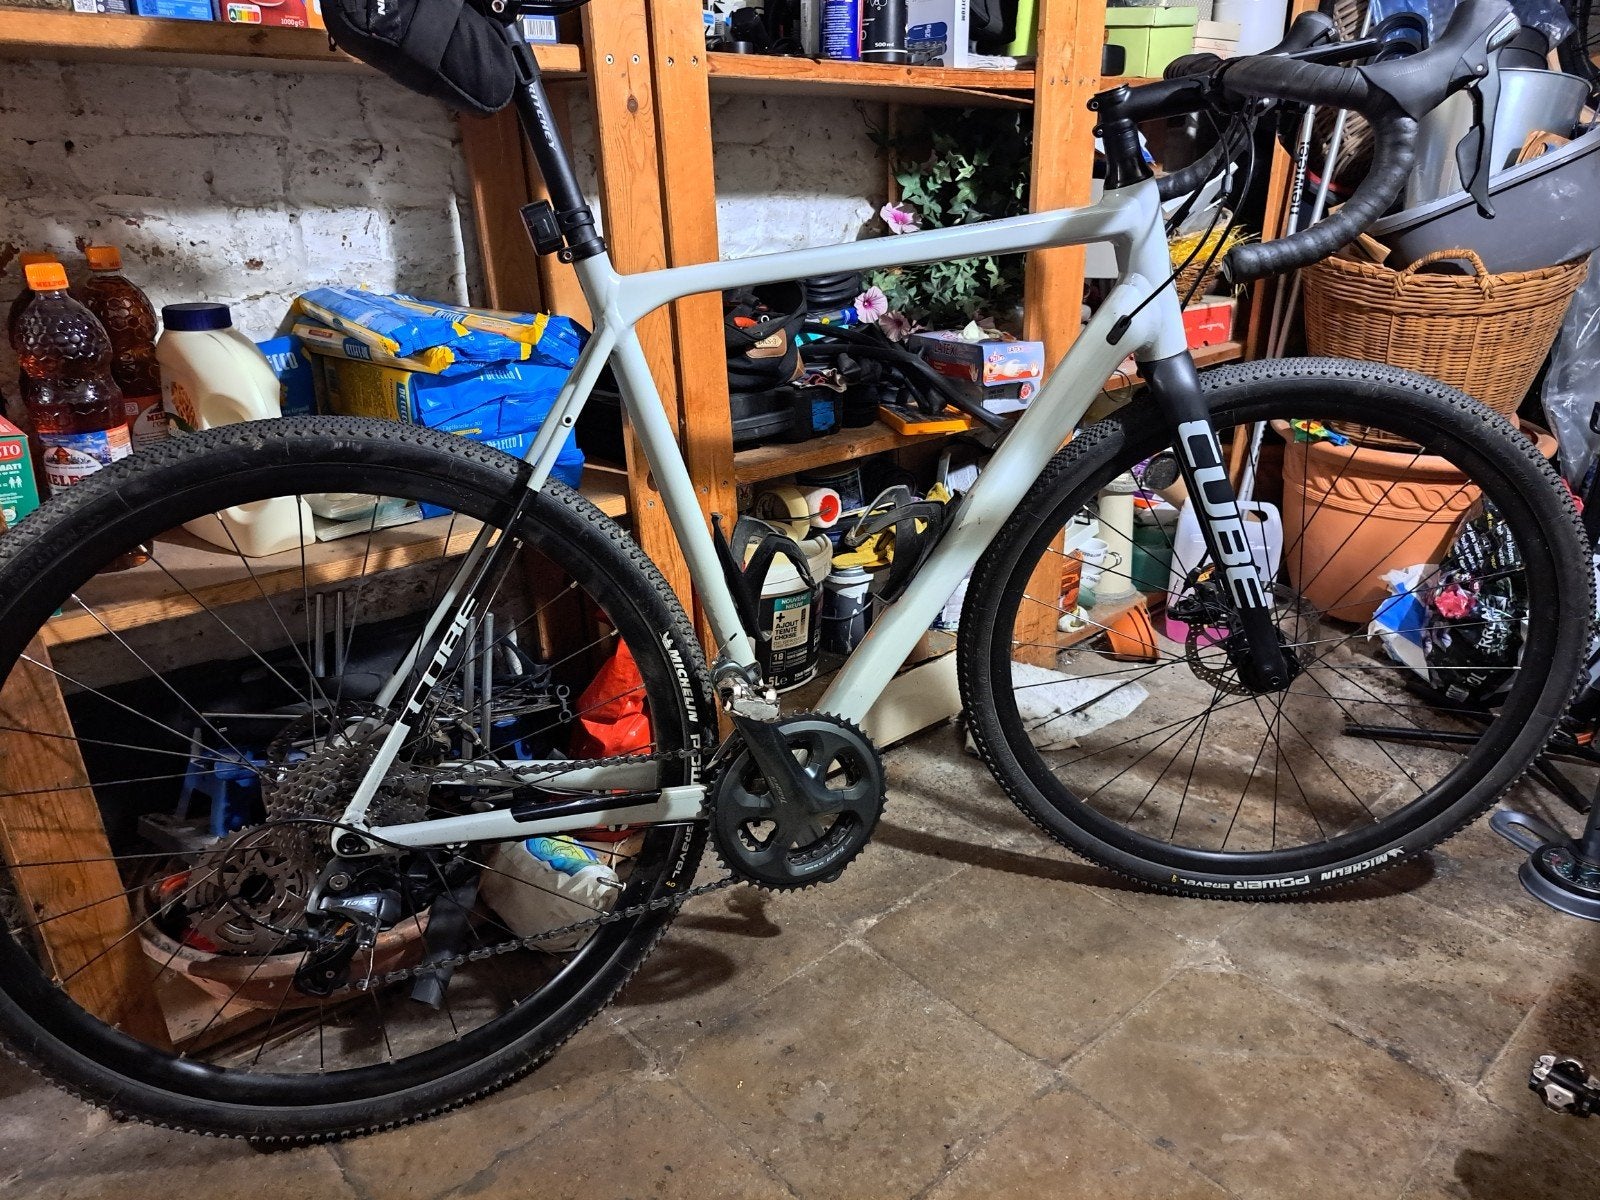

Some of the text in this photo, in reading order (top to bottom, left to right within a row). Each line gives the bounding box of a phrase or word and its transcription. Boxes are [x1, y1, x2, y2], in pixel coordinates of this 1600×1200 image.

[528, 84, 557, 151] RITCHEY
[1178, 419, 1267, 609] CUBE
[775, 626, 798, 636] TEINTE
[776, 620, 799, 629] AJOUT
[407, 592, 480, 714] CUBE
[773, 653, 784, 661] 18
[668, 649, 699, 722] MICHELIN
[1320, 852, 1388, 882] MICHELIN
[1233, 874, 1311, 890] POWER
[342, 899, 378, 907] Tiagra
